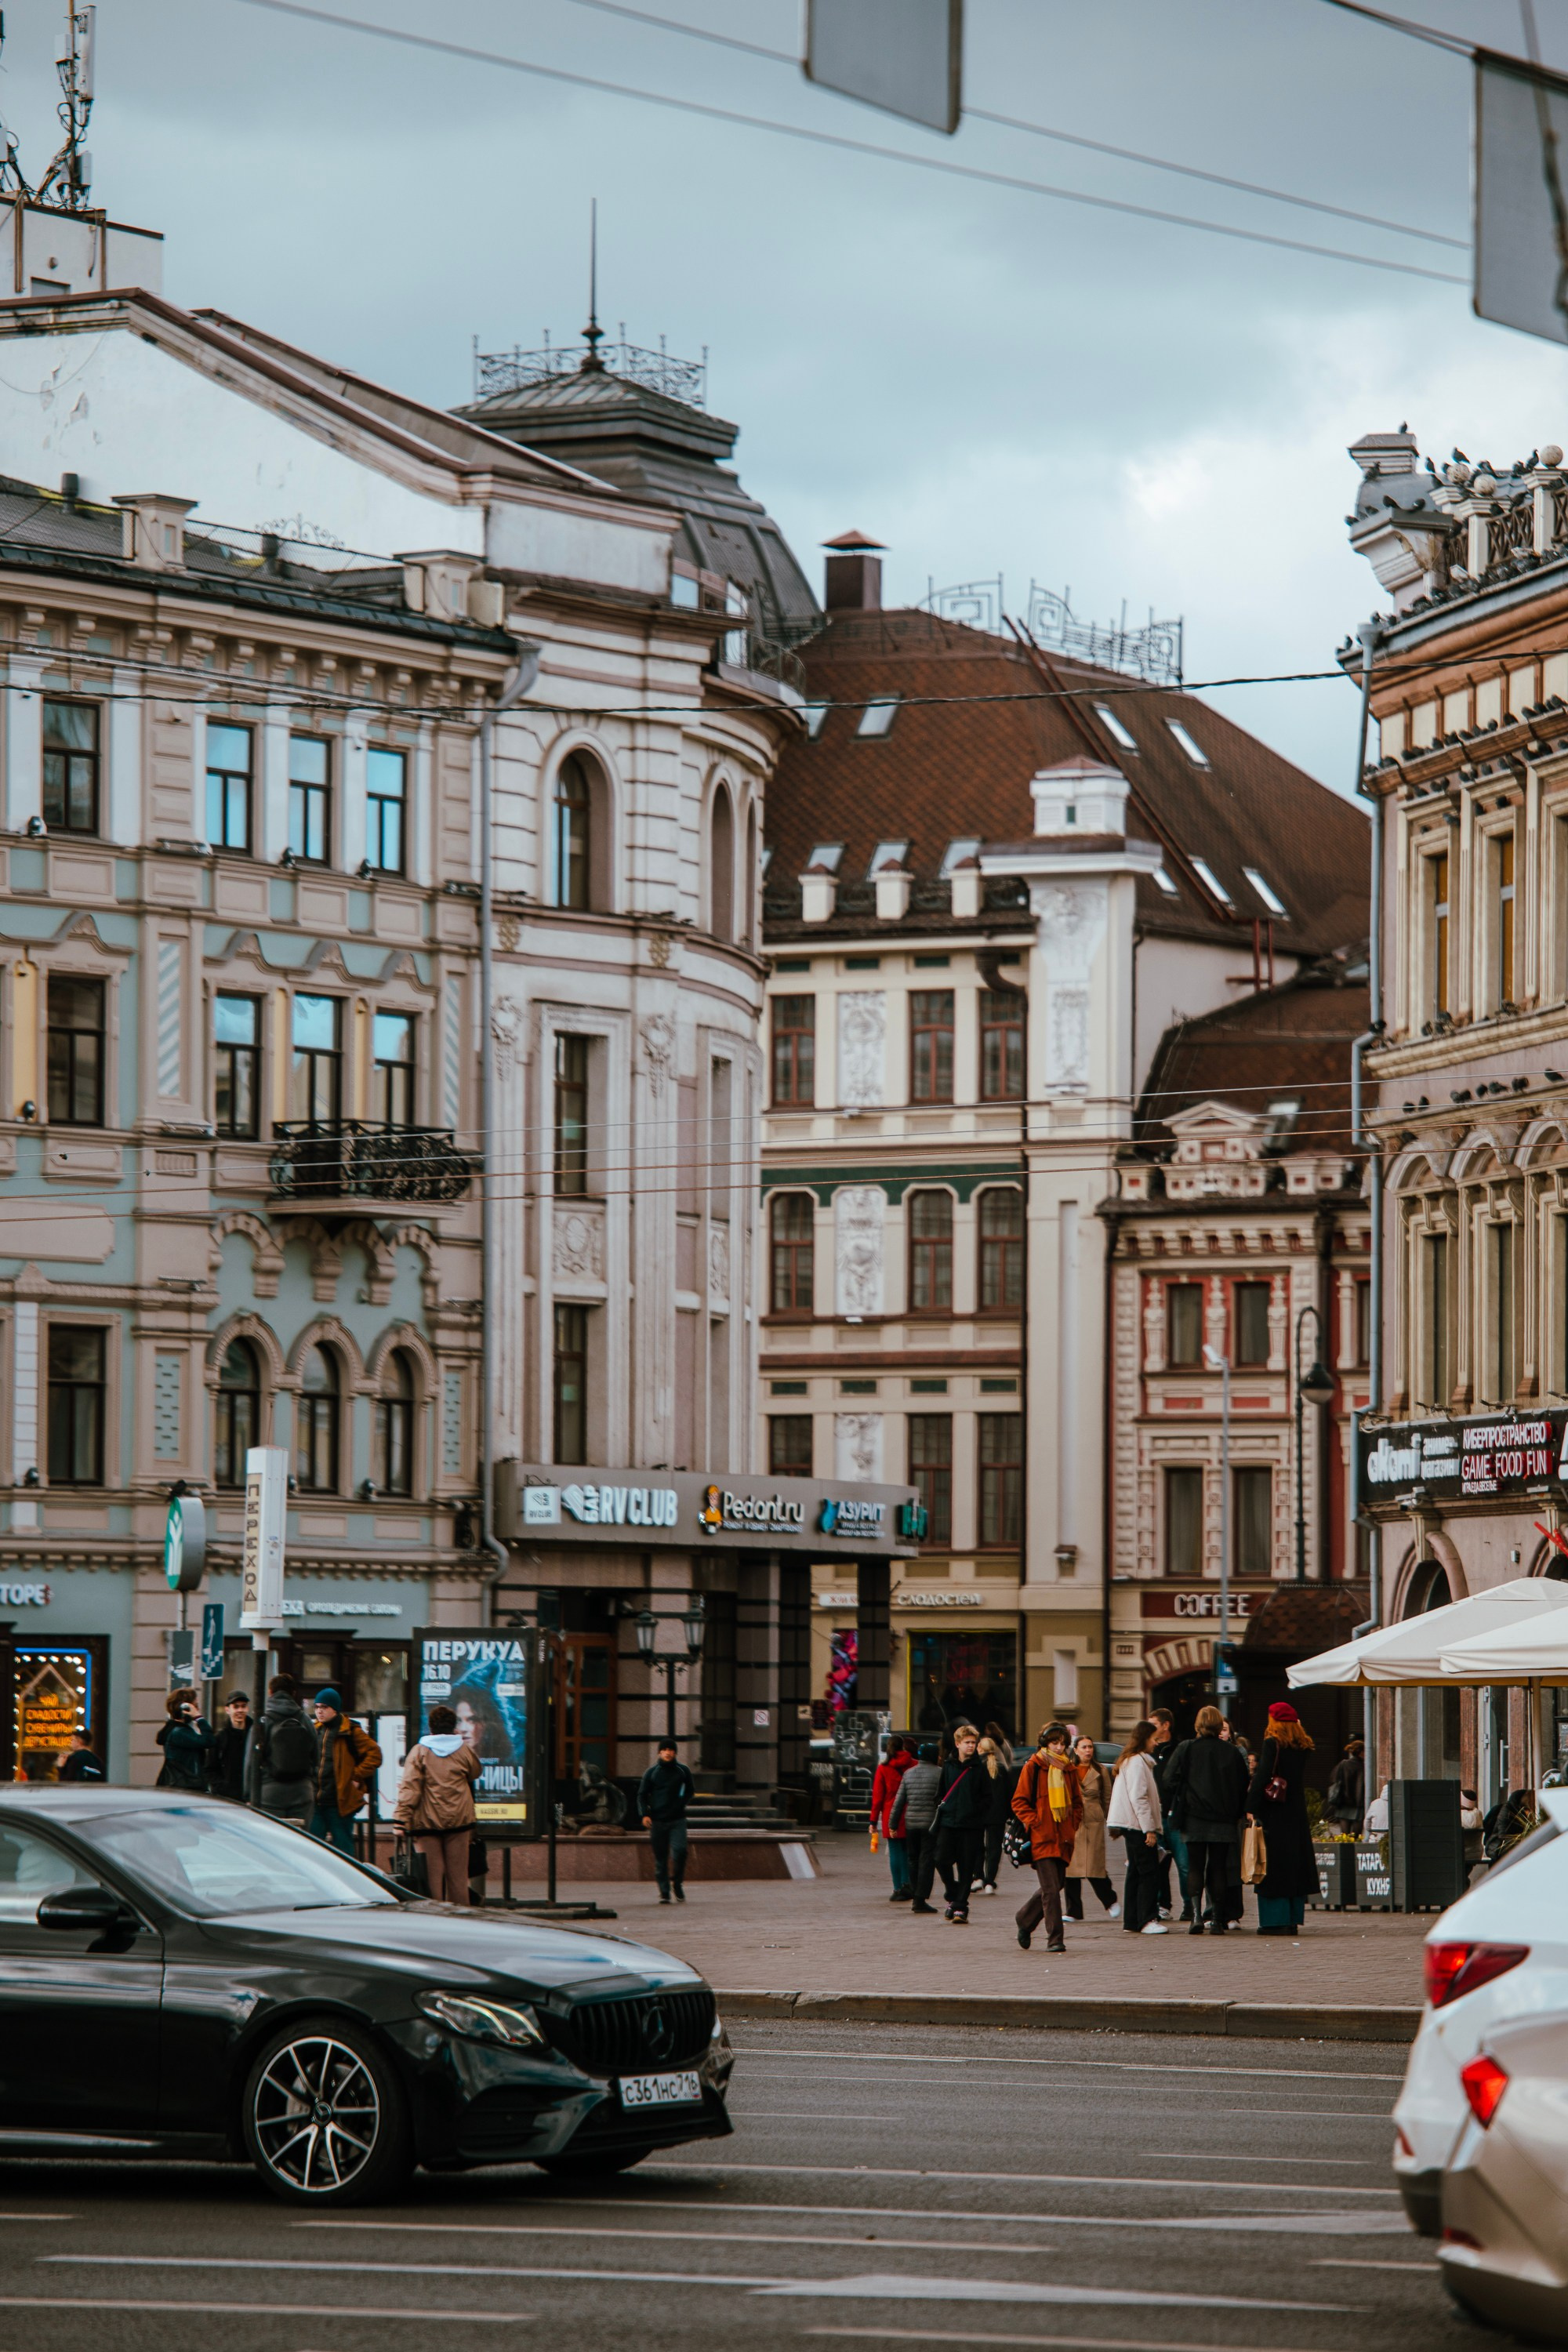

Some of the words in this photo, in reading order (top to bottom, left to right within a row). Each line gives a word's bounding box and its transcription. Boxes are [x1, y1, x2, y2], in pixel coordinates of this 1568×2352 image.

[1463, 1421, 1547, 1450] КИБЕРПРОСТРАНСТВО
[1367, 1433, 1421, 1483] akami
[1421, 1458, 1459, 1480] магазин
[1495, 1451, 1523, 1477] FOOD
[1526, 1450, 1548, 1475] FUN
[583, 1484, 600, 1523] БАР
[600, 1486, 628, 1524] RV
[629, 1487, 678, 1526] CLUB
[723, 1490, 804, 1523] Pedant.ru
[837, 1501, 886, 1520] АЗУРИТ
[244, 1484, 260, 1602] ПЕРЕХОД
[1174, 1594, 1252, 1617] COFFEE
[423, 1641, 525, 1661] ПЕРУКУА
[423, 1664, 451, 1680] 16.10
[1356, 1853, 1386, 1871] ТАТАРС
